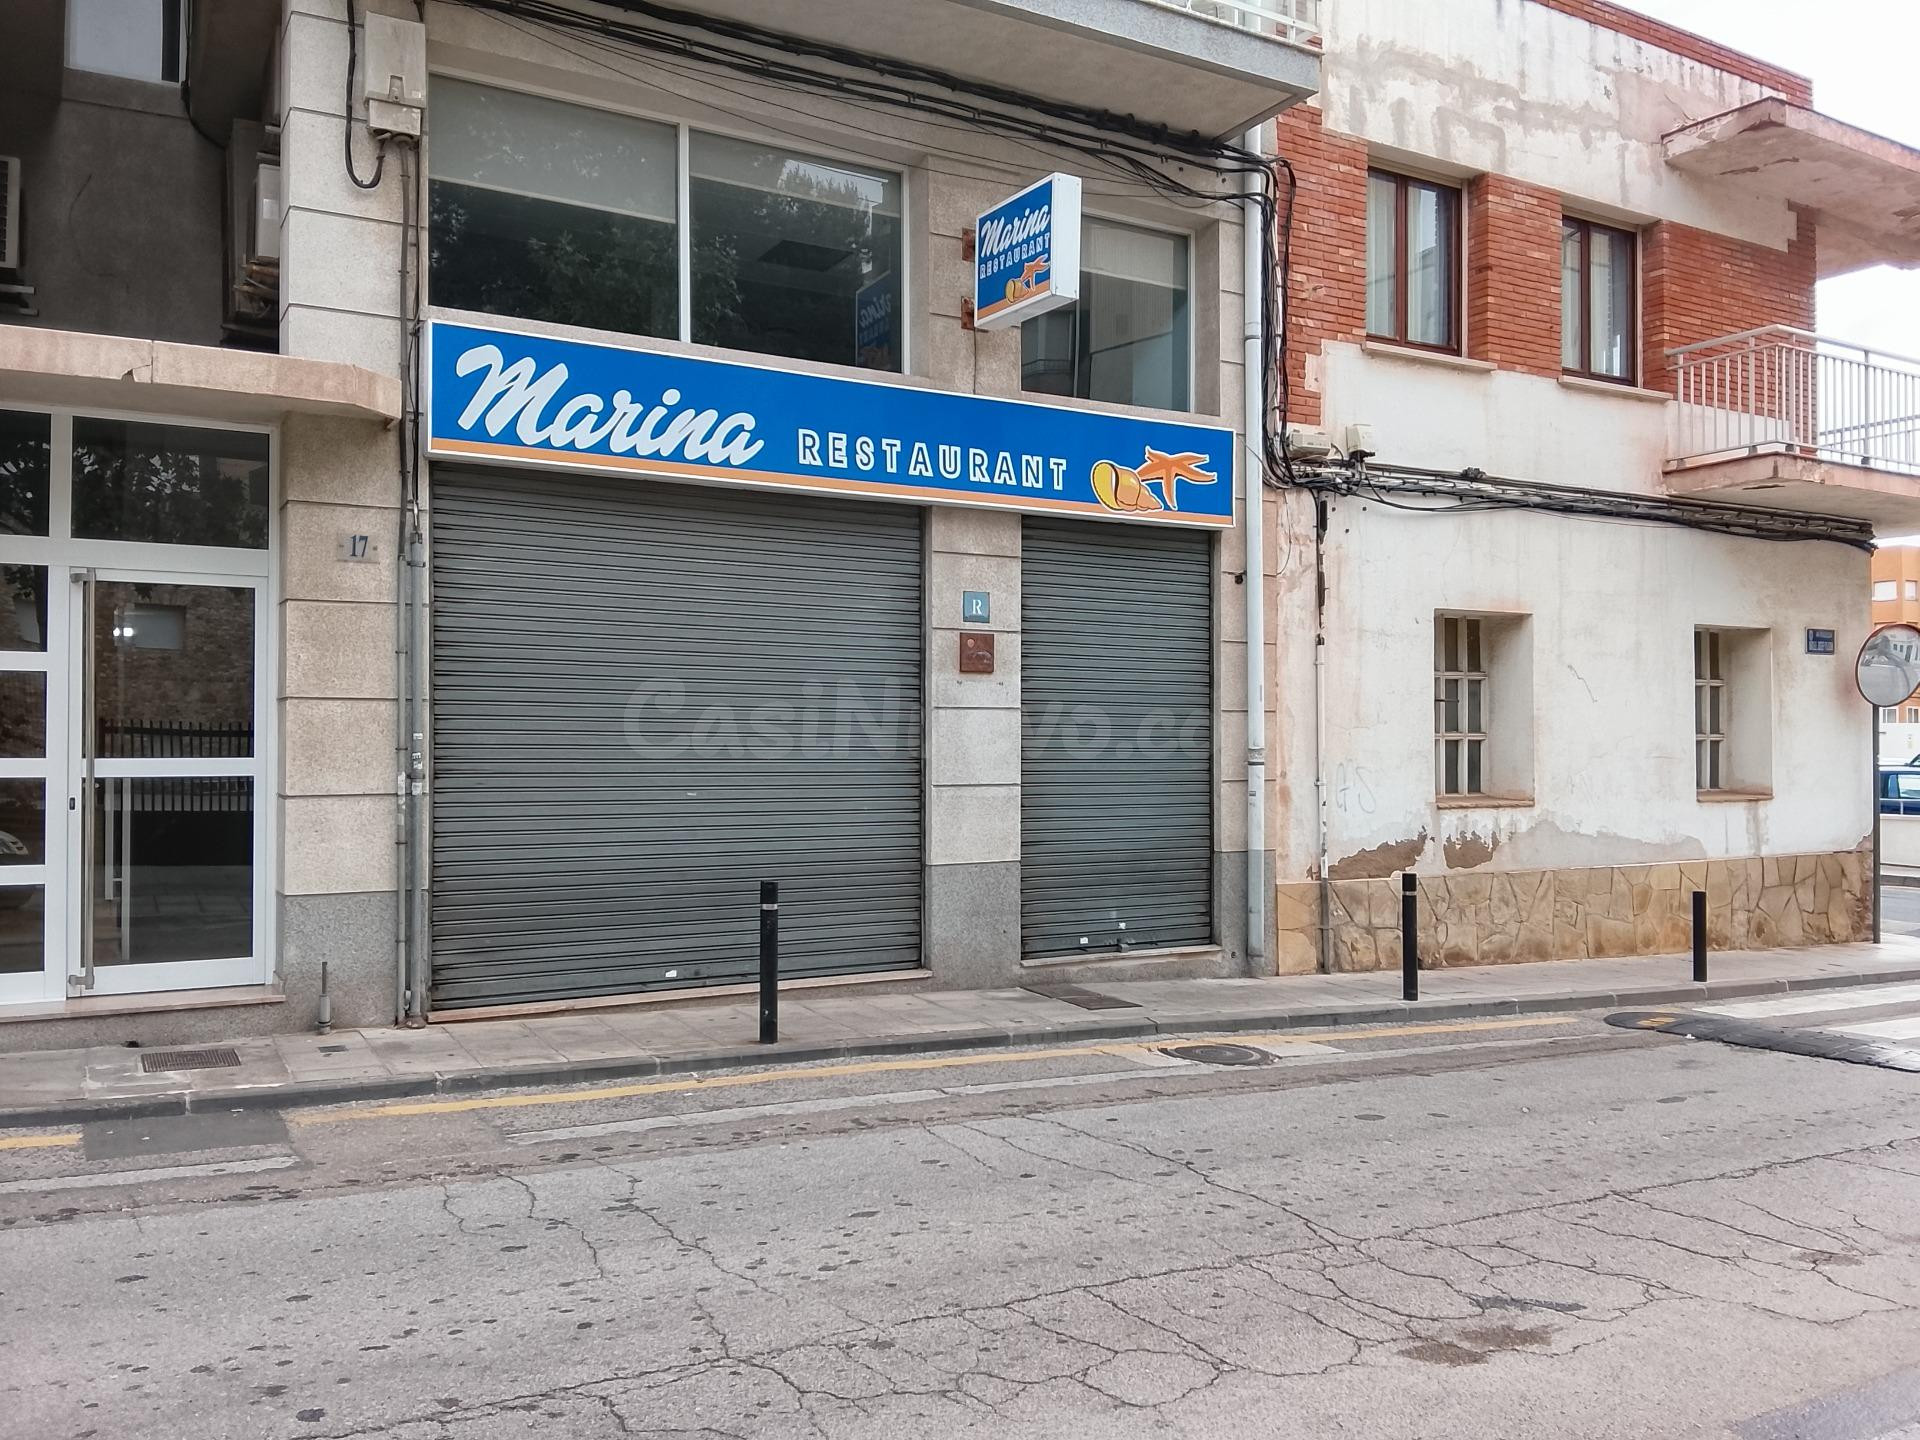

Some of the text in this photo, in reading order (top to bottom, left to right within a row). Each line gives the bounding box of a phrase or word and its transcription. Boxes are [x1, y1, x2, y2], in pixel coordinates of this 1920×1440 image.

[979, 231, 1050, 280] RESTAURANT
[980, 204, 1050, 258] Marina
[455, 344, 765, 466] Marina
[797, 428, 1067, 491] RESTAURANT
[350, 534, 369, 558] 17
[972, 599, 982, 615] R
